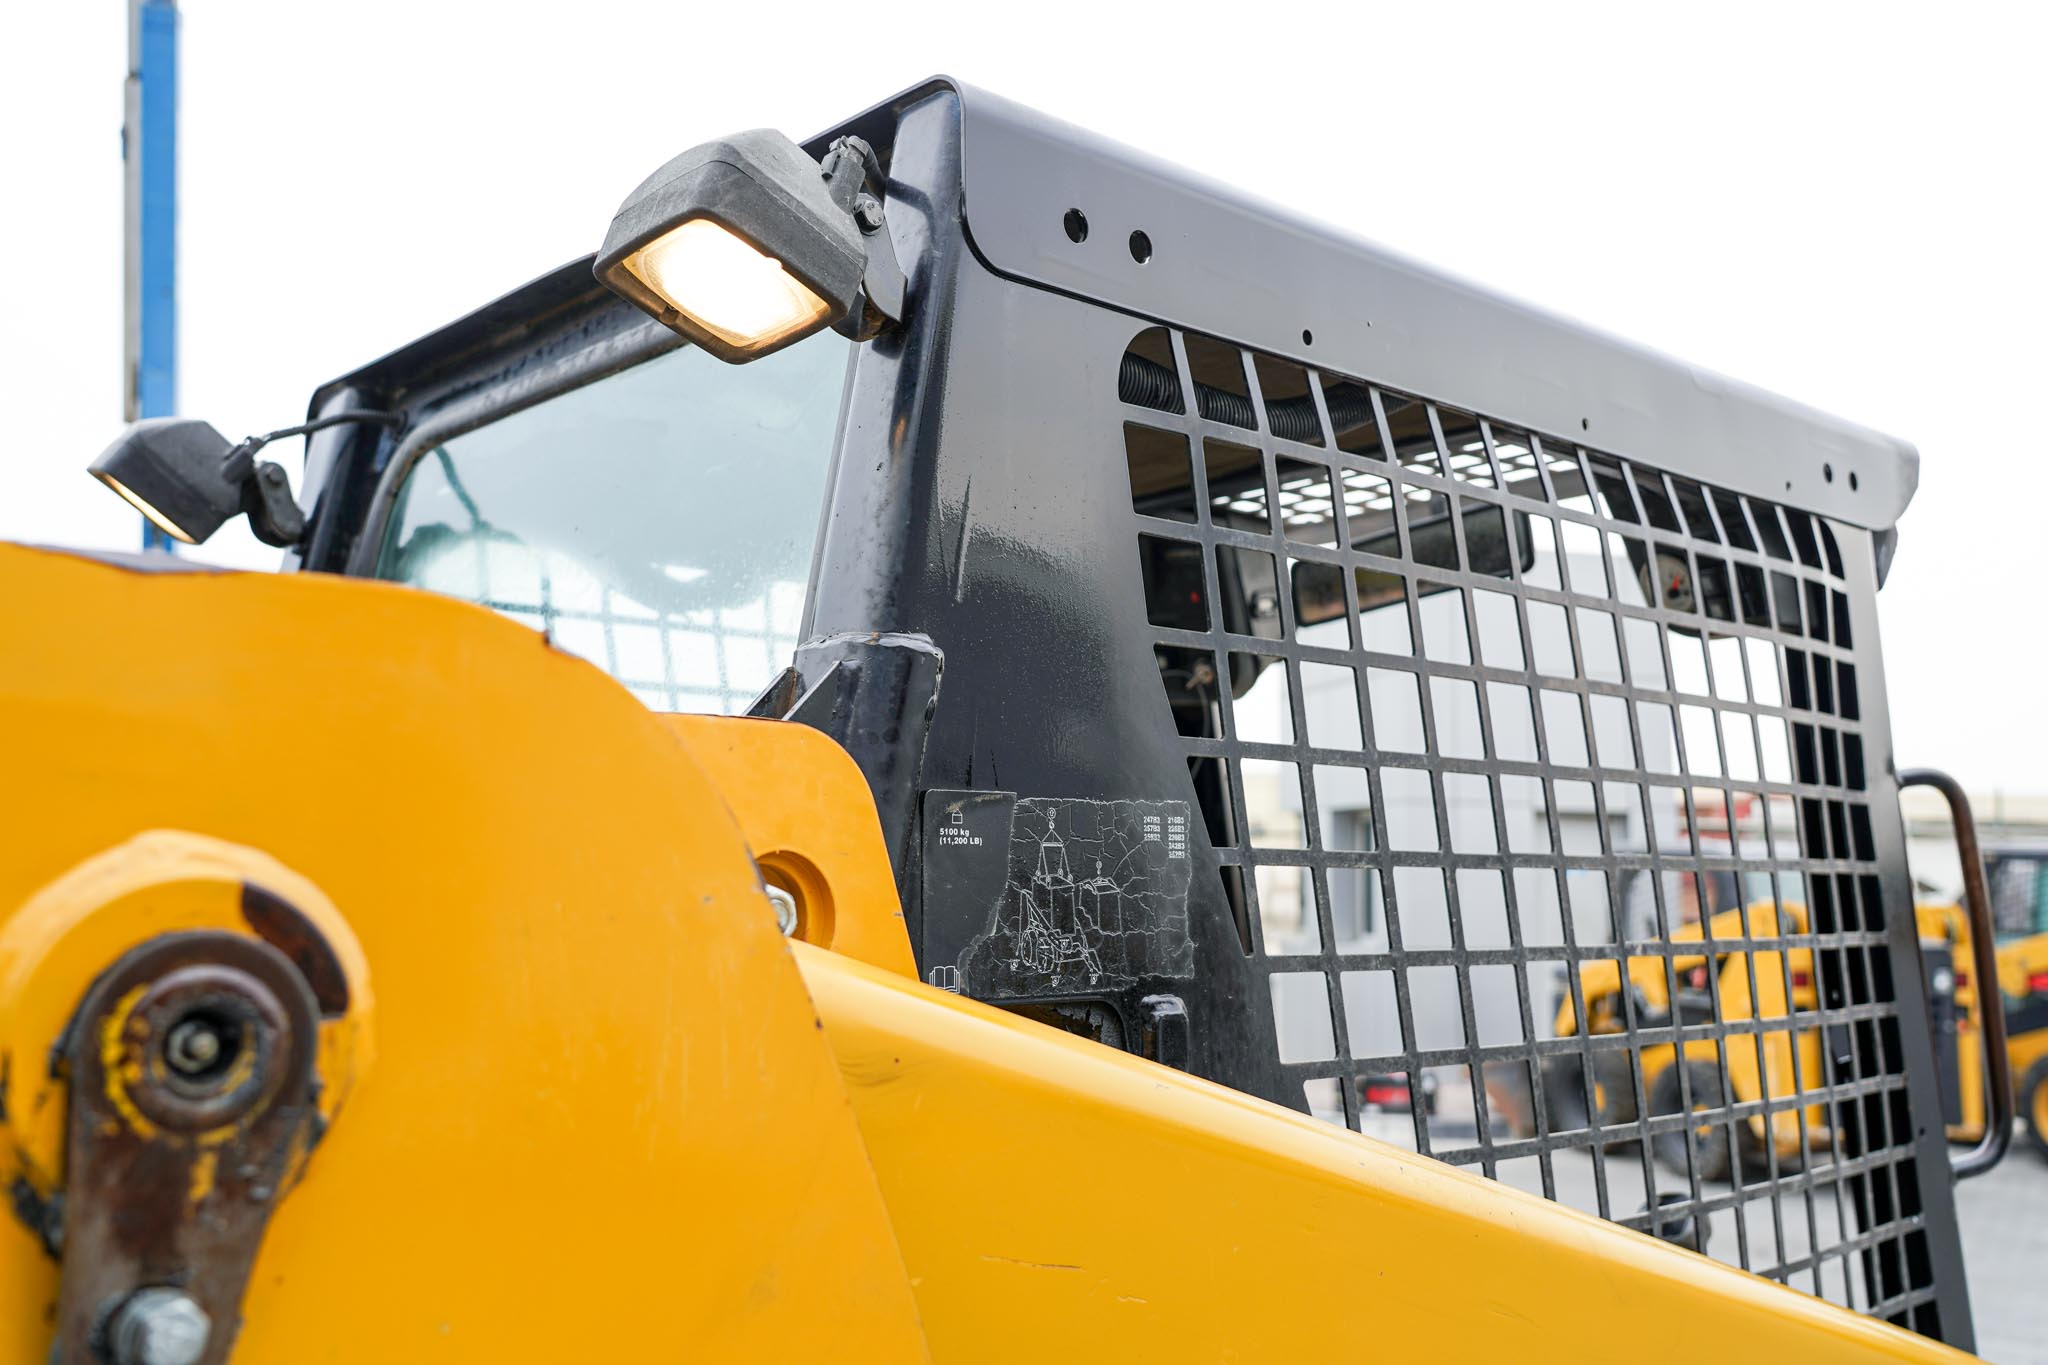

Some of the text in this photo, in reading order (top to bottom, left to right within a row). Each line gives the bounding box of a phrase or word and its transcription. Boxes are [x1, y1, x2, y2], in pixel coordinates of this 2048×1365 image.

[939, 827, 970, 837] 5100 kg
[939, 837, 982, 846] (11,200 LB)
